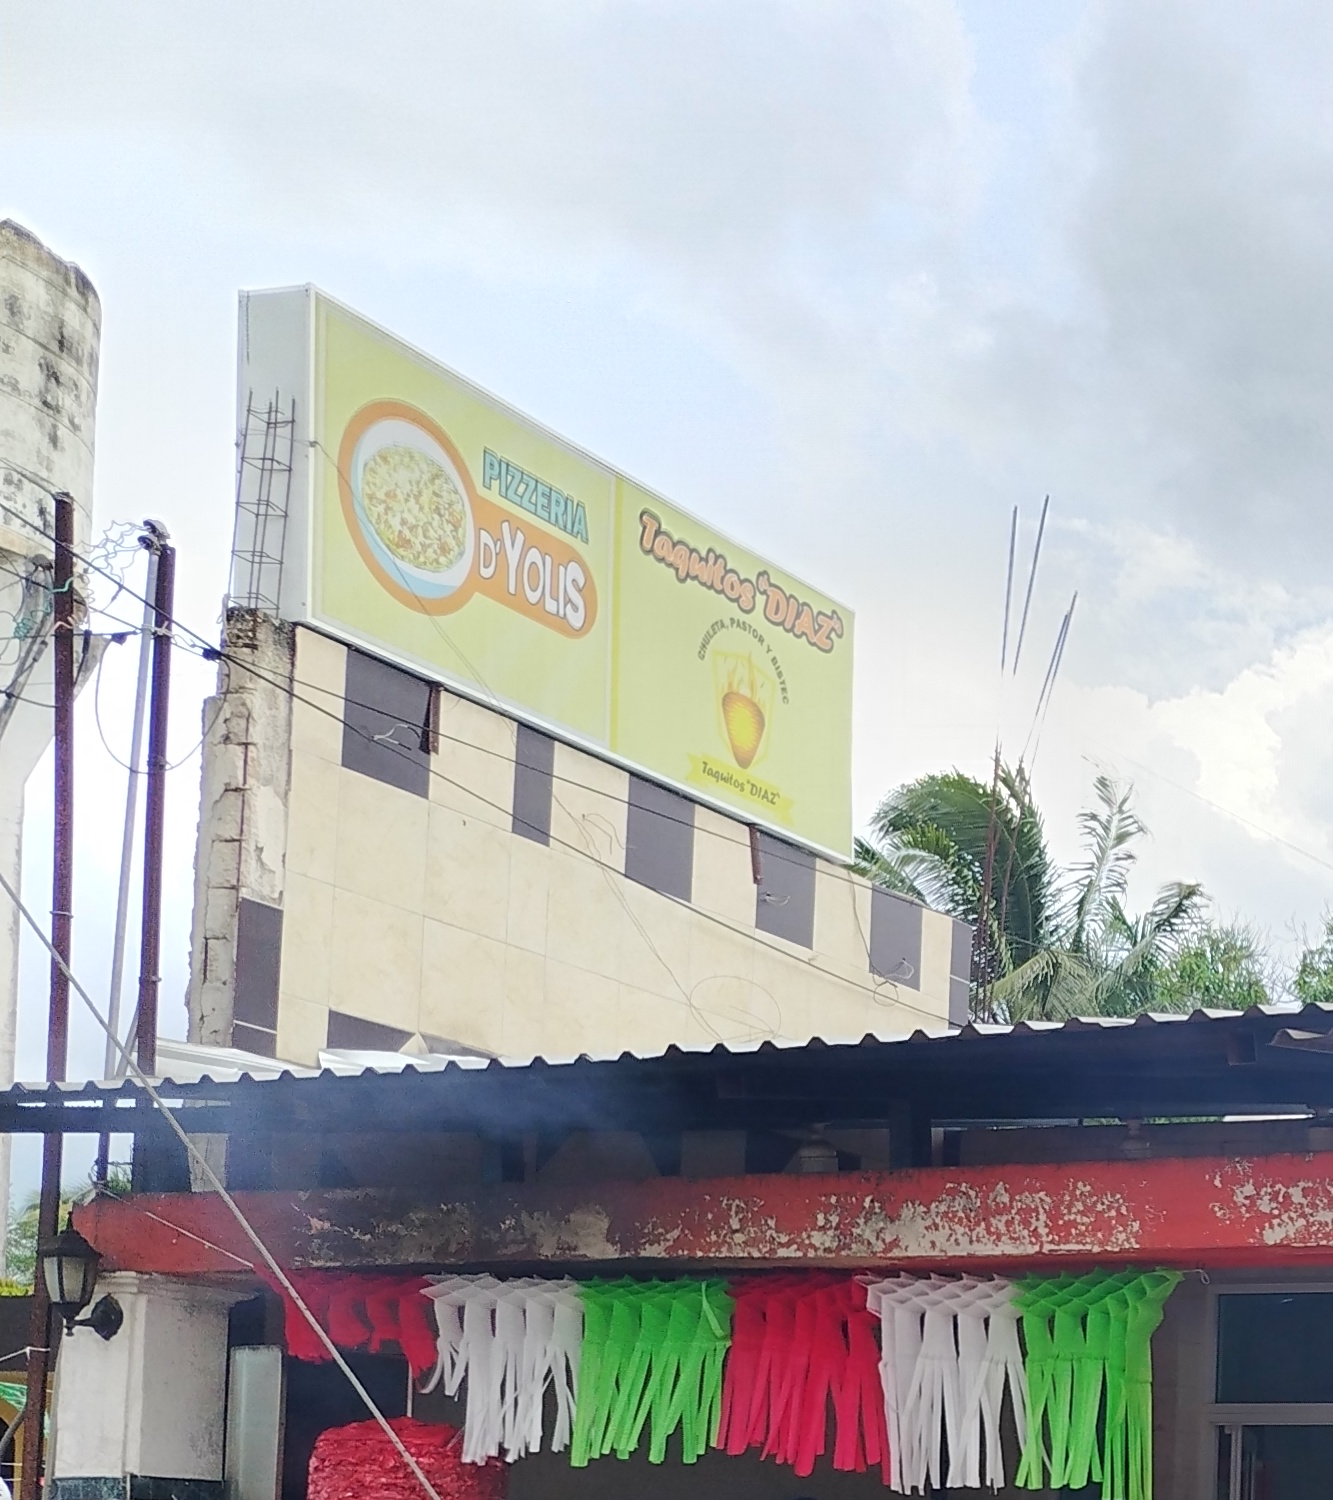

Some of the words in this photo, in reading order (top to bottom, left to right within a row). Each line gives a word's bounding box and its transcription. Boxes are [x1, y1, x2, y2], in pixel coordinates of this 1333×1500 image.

[483, 446, 589, 544] PIZZERIA
[479, 519, 586, 631] D'YOLIS
[639, 508, 755, 614] Taquitos
[730, 617, 765, 646] PASTOR
[766, 644, 773, 654] Y
[771, 656, 789, 705] BISTEC
[702, 761, 745, 792] Taquitos
